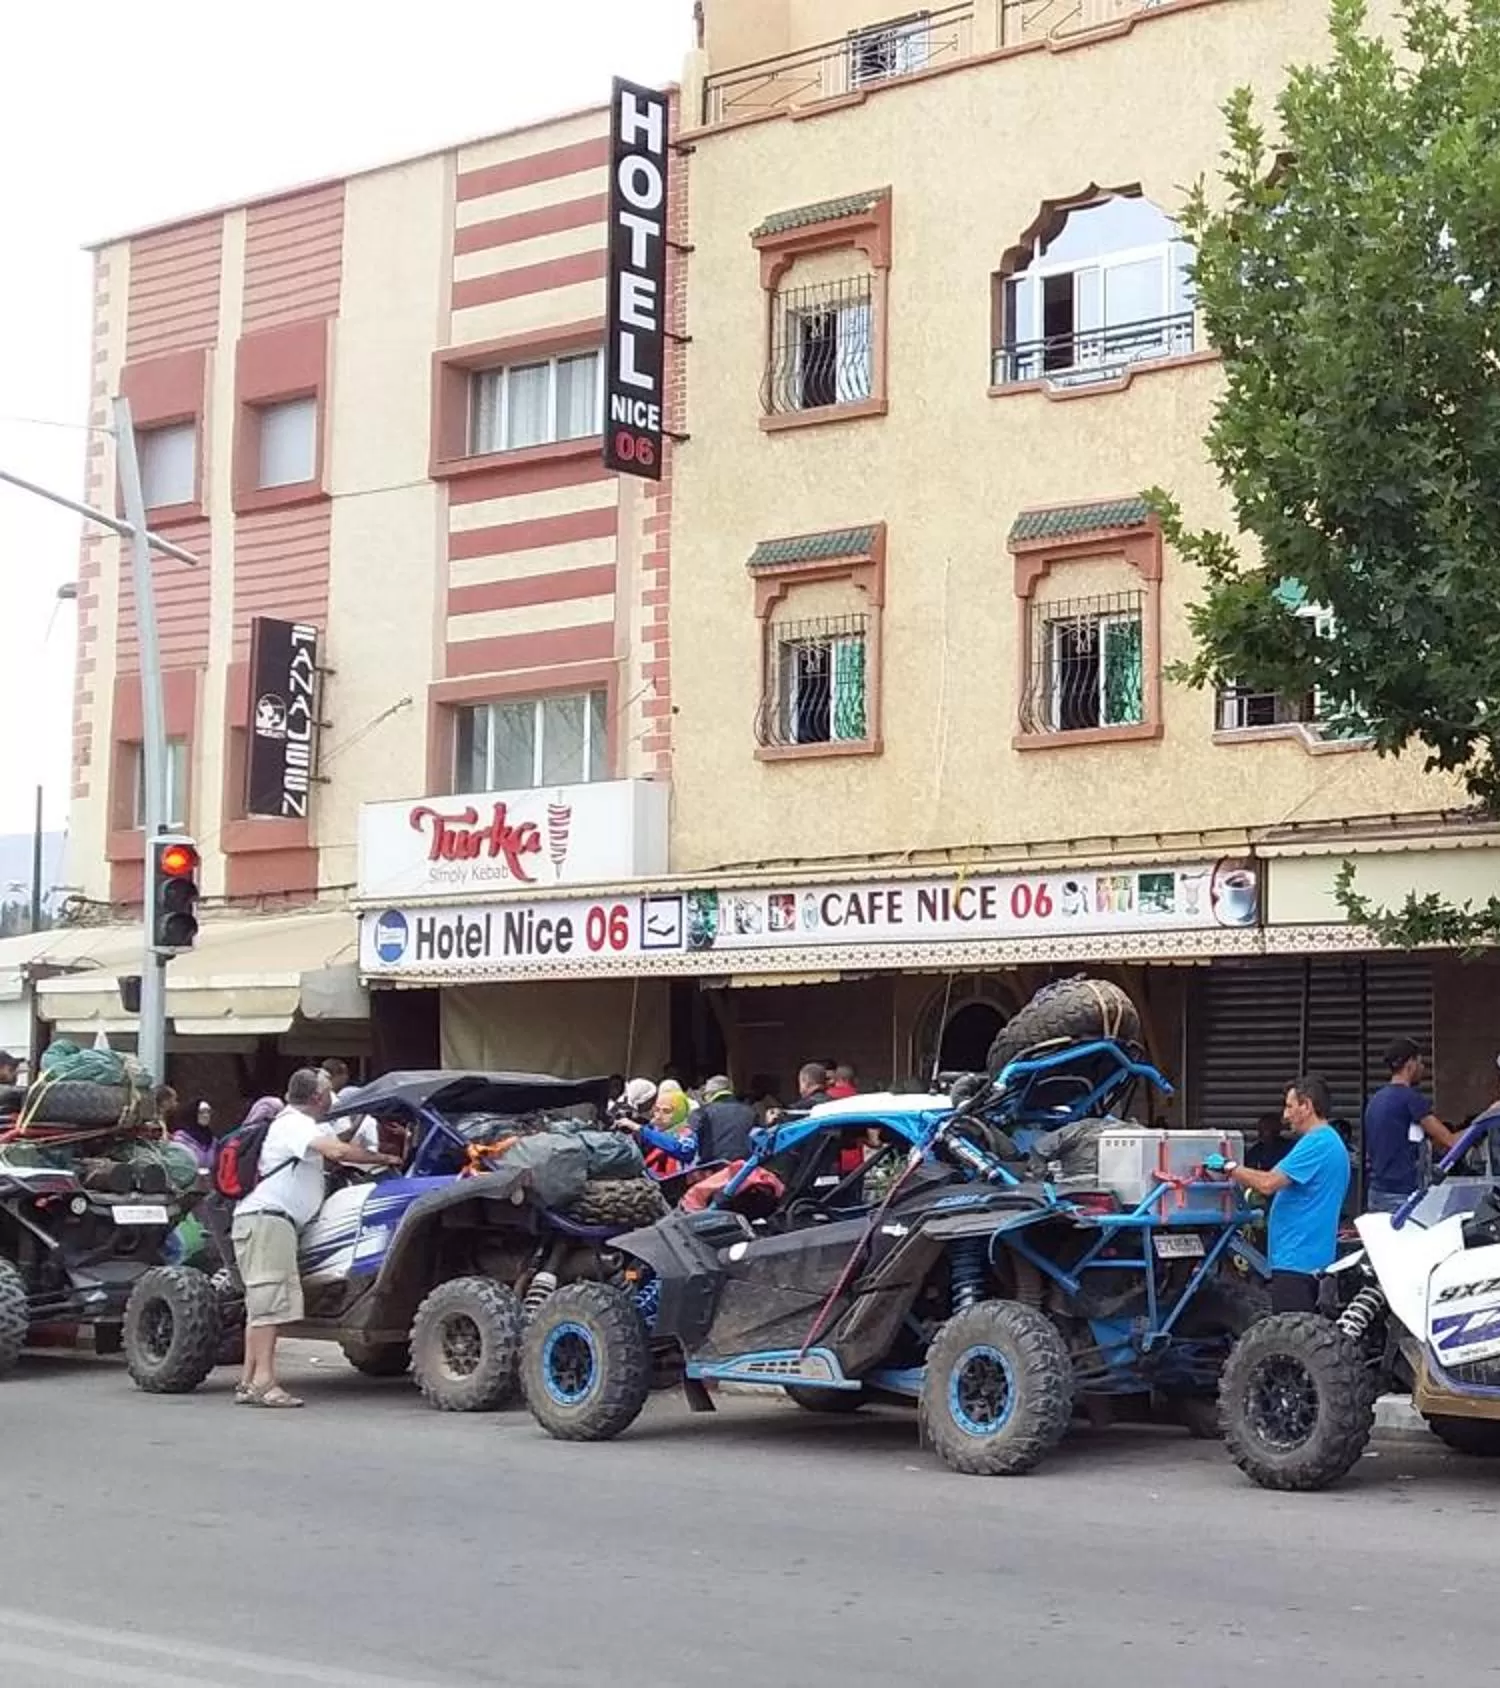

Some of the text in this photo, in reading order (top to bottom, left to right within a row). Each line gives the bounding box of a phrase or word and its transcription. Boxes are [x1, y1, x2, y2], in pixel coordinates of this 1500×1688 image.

[617, 91, 662, 390] HOTEL
[611, 394, 660, 432] NICE
[614, 431, 655, 466] 06
[409, 801, 543, 883] Turka
[429, 863, 510, 885] Simply Kebab
[820, 882, 1054, 927] CAFE NICE 06
[415, 904, 630, 960] Hotel Nice 06
